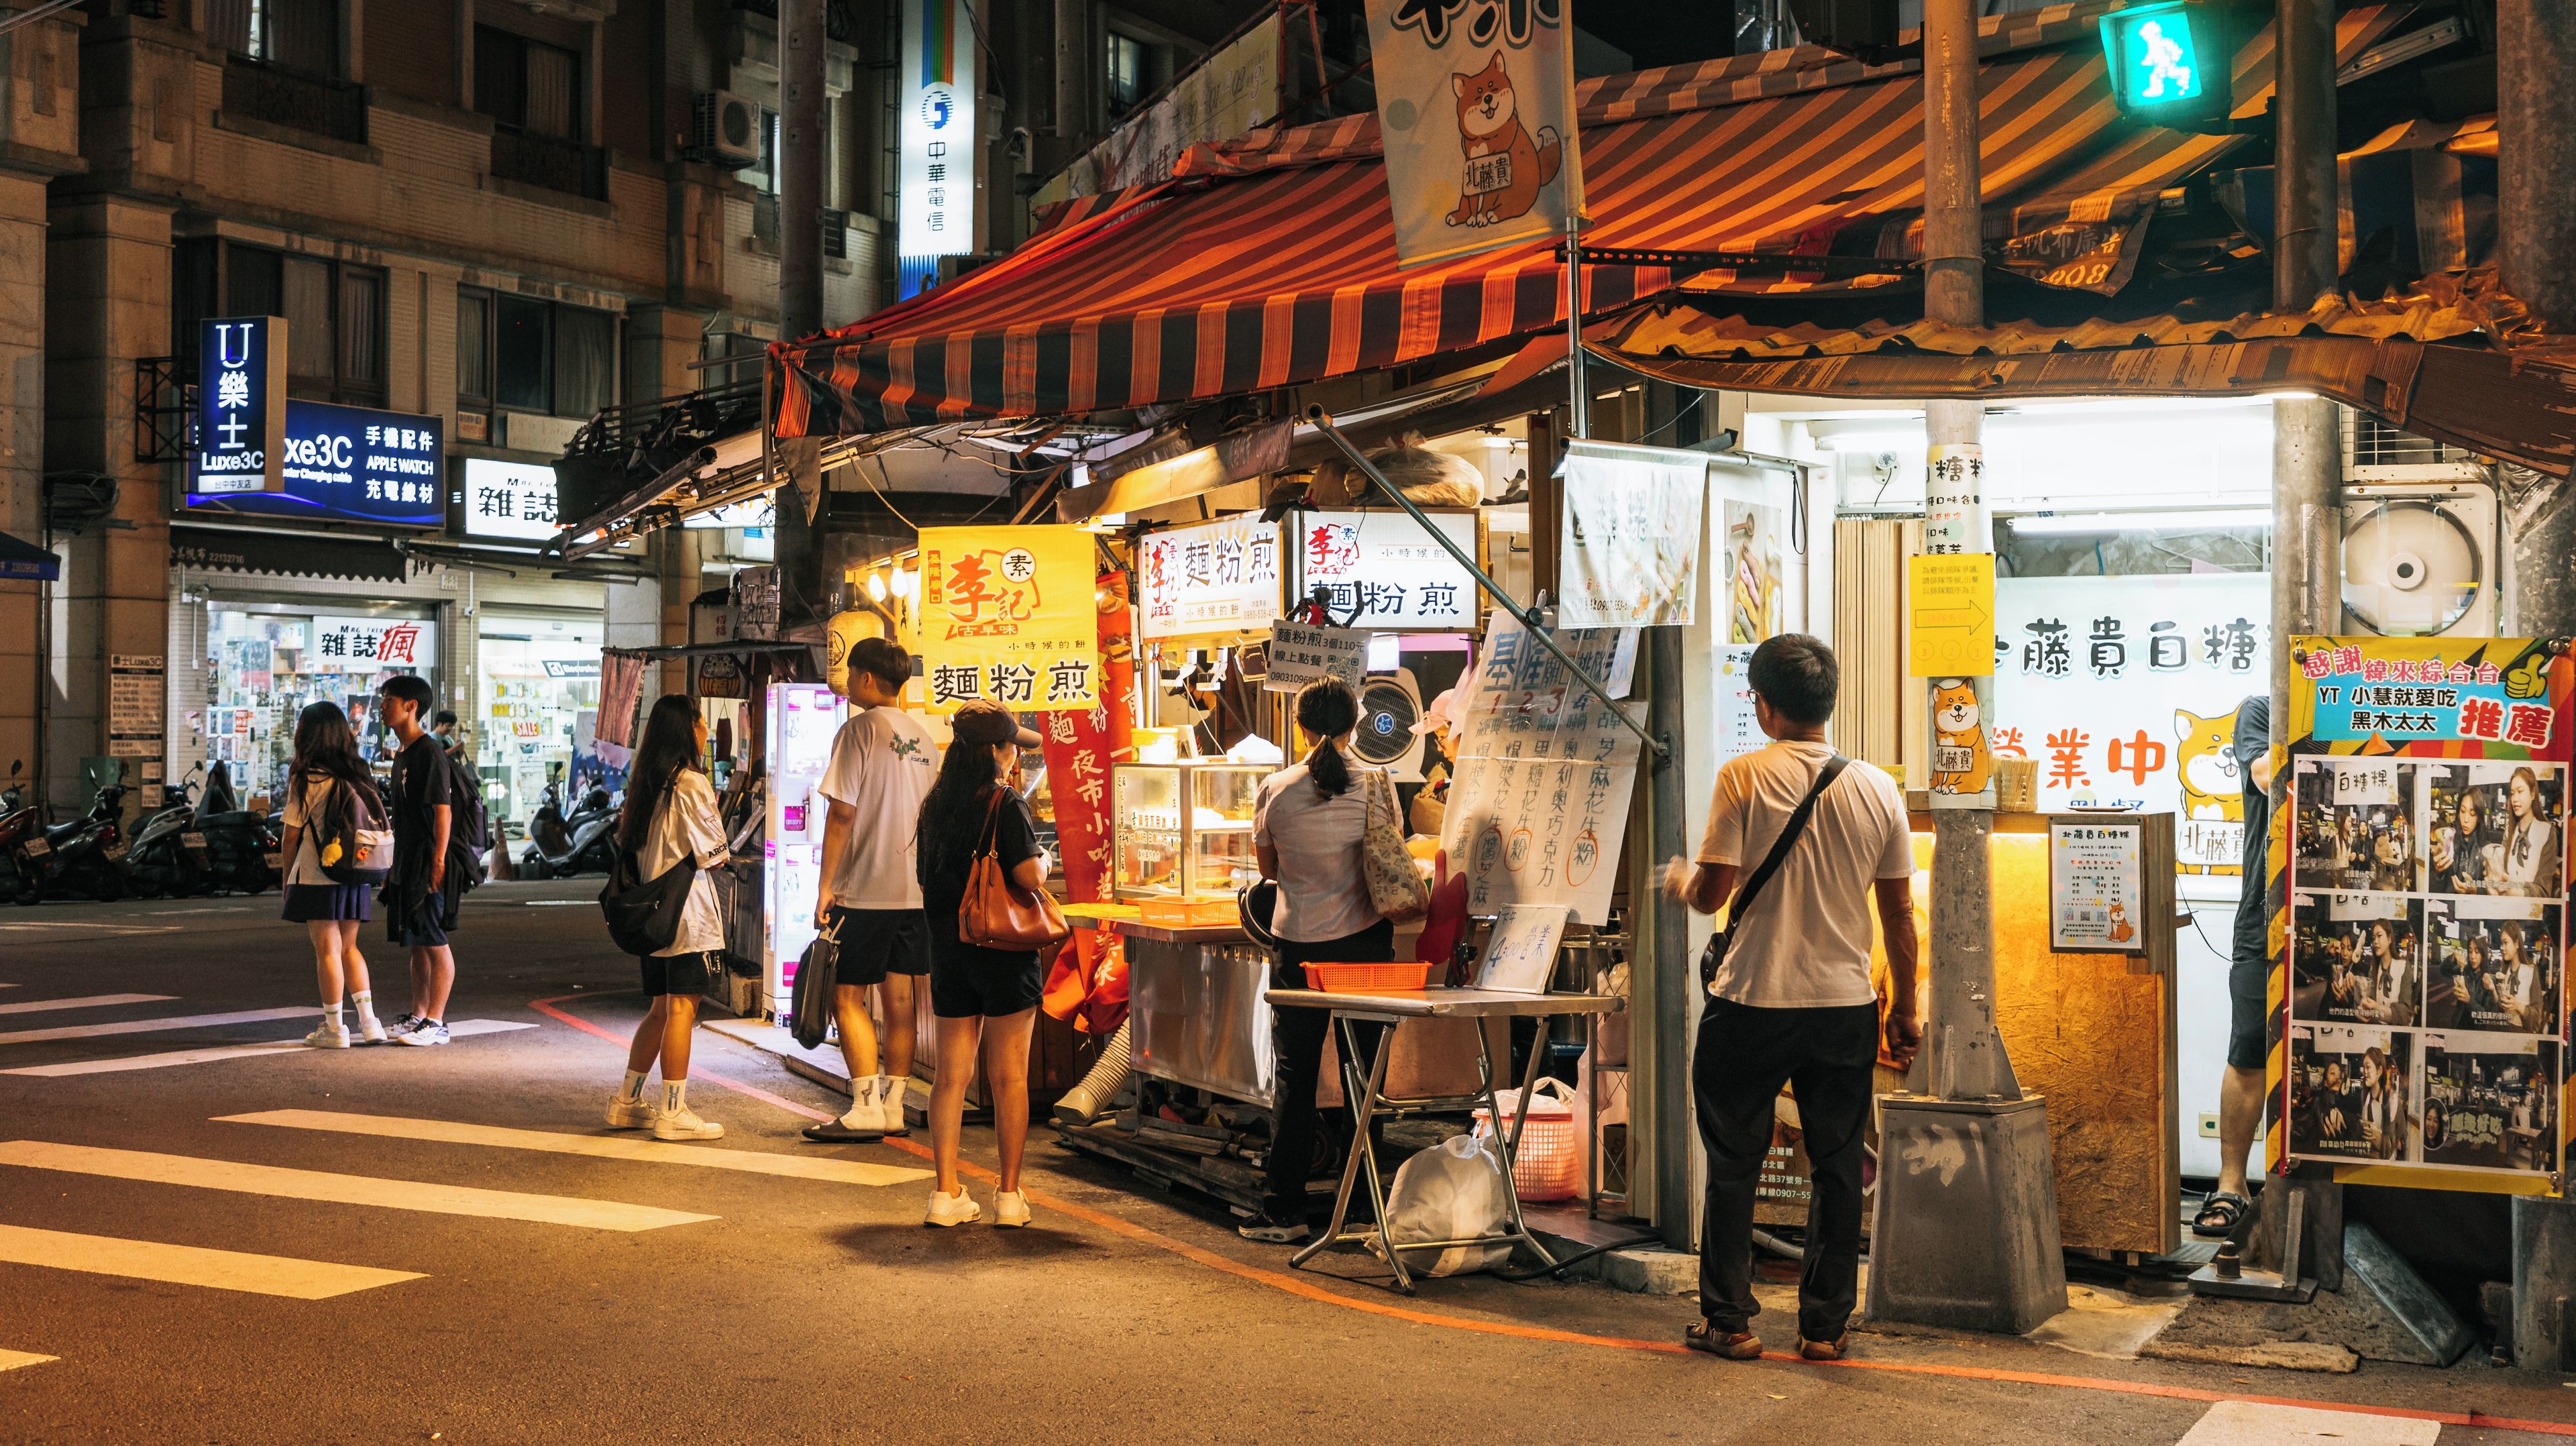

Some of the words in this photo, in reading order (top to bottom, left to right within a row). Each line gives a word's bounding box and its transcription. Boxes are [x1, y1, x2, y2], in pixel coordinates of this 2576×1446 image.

[1466, 156, 1509, 190] 北藤貴
[927, 140, 946, 231] 中華電信
[366, 425, 433, 451] 手機配件
[202, 451, 264, 471] Luxe3C
[284, 434, 353, 468] xe3C
[366, 455, 398, 472] APPLE
[398, 457, 434, 476] WATCH
[366, 478, 433, 504] 充電線材
[1341, 527, 1356, 541] 素
[1927, 528, 1949, 538] 口味
[1185, 532, 1276, 588] 麵粉煎
[1382, 548, 1446, 559] 小時候的
[1006, 555, 1032, 577] 素
[945, 554, 1032, 622] 李記
[1187, 604, 1239, 618] 小時候的餅
[960, 624, 1017, 636] 古早味
[1276, 628, 1323, 648] 麵粉煎
[1323, 638, 1364, 653] 3個110元
[321, 620, 423, 664] 雜誌瘋
[1008, 640, 1086, 651] 小時候的餅
[1921, 648, 1927, 657] 3
[1949, 648, 1954, 656] 2
[1975, 649, 1980, 657] 1
[1995, 616, 2271, 676] 藤貴白糖
[1275, 649, 1322, 667] 線上點餐
[1483, 626, 1554, 692] 基隆
[2304, 645, 2363, 679] 感謝
[2365, 661, 2501, 684] 緯來綜合台
[933, 660, 1092, 704] 麵粉煎
[1271, 671, 1316, 684] 09031096
[1491, 693, 1501, 714] 1
[1518, 691, 1534, 714] 2
[1547, 687, 1567, 714] 3
[2319, 687, 2341, 704] YT
[2351, 686, 2457, 707] 小慧就愛吃
[517, 720, 539, 737] SALE
[2351, 712, 2436, 732] 黑木太太
[2459, 700, 2551, 746] 推薦
[1935, 747, 1972, 769] 北藤貴
[2339, 769, 2387, 793] 白糖粿
[1537, 738, 1578, 887] 奧利奧巧克力
[1573, 738, 1615, 867] 芝麻花生粉
[2063, 830, 2130, 840] 北藤貴白糖粿
[1502, 910, 1517, 924] 下午
[1489, 936, 1520, 968] 4:00
